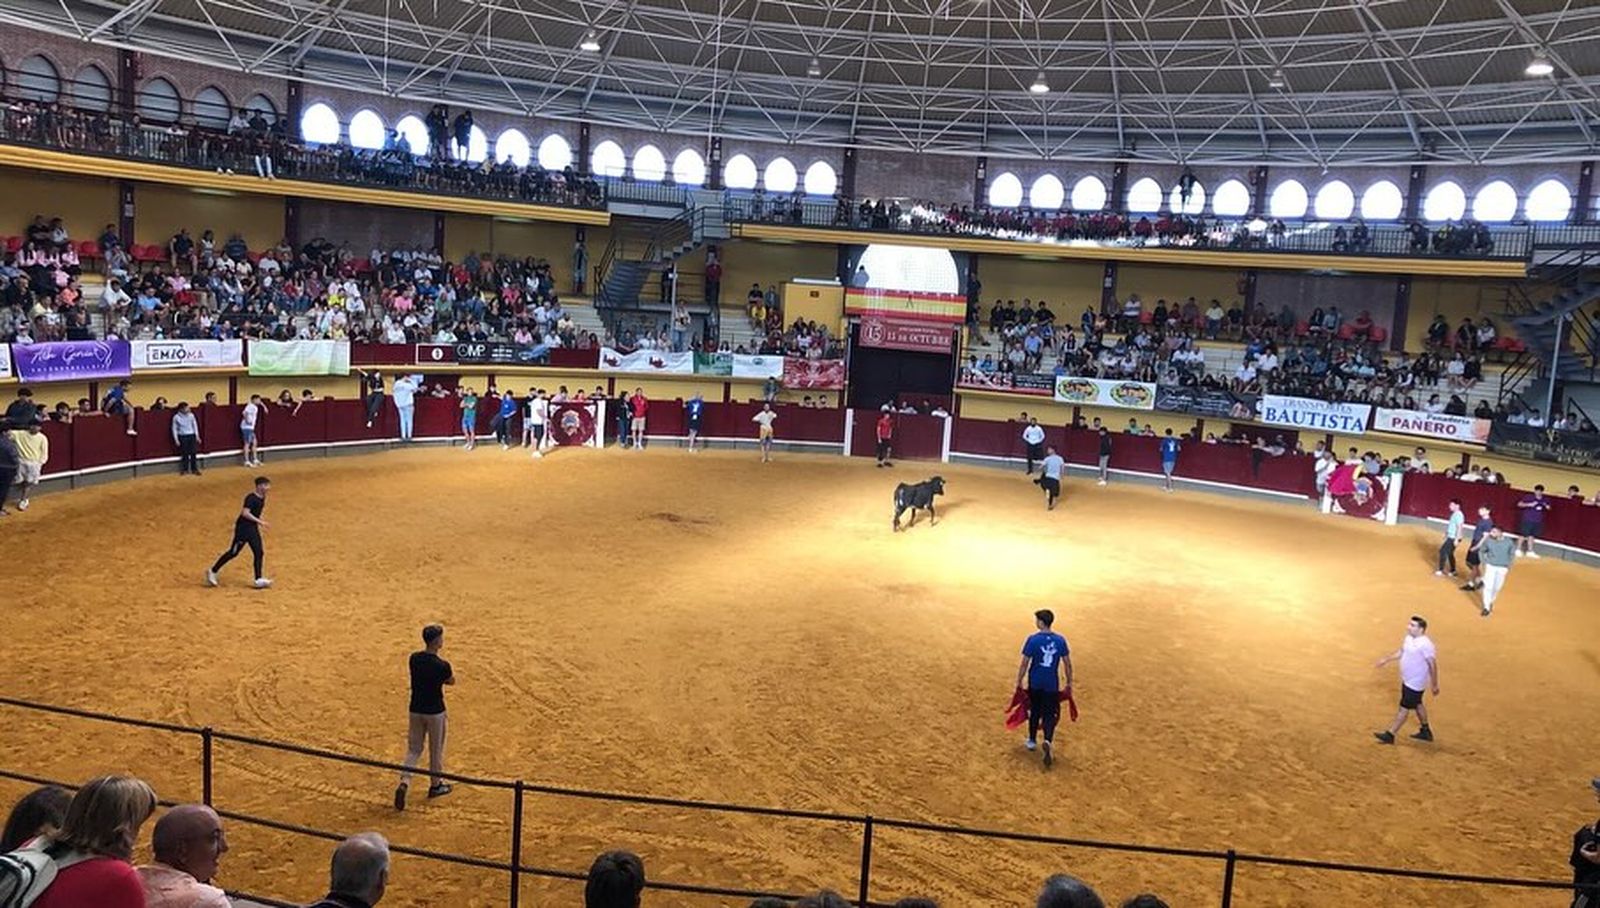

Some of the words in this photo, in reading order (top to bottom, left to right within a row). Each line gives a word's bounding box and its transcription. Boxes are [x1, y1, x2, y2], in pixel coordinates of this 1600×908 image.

[908, 333, 950, 346] OCTUBRE
[1282, 399, 1353, 414] TRANSPORTES
[1265, 407, 1364, 432] BAUTISTA
[1391, 415, 1457, 434] PAÑERO
